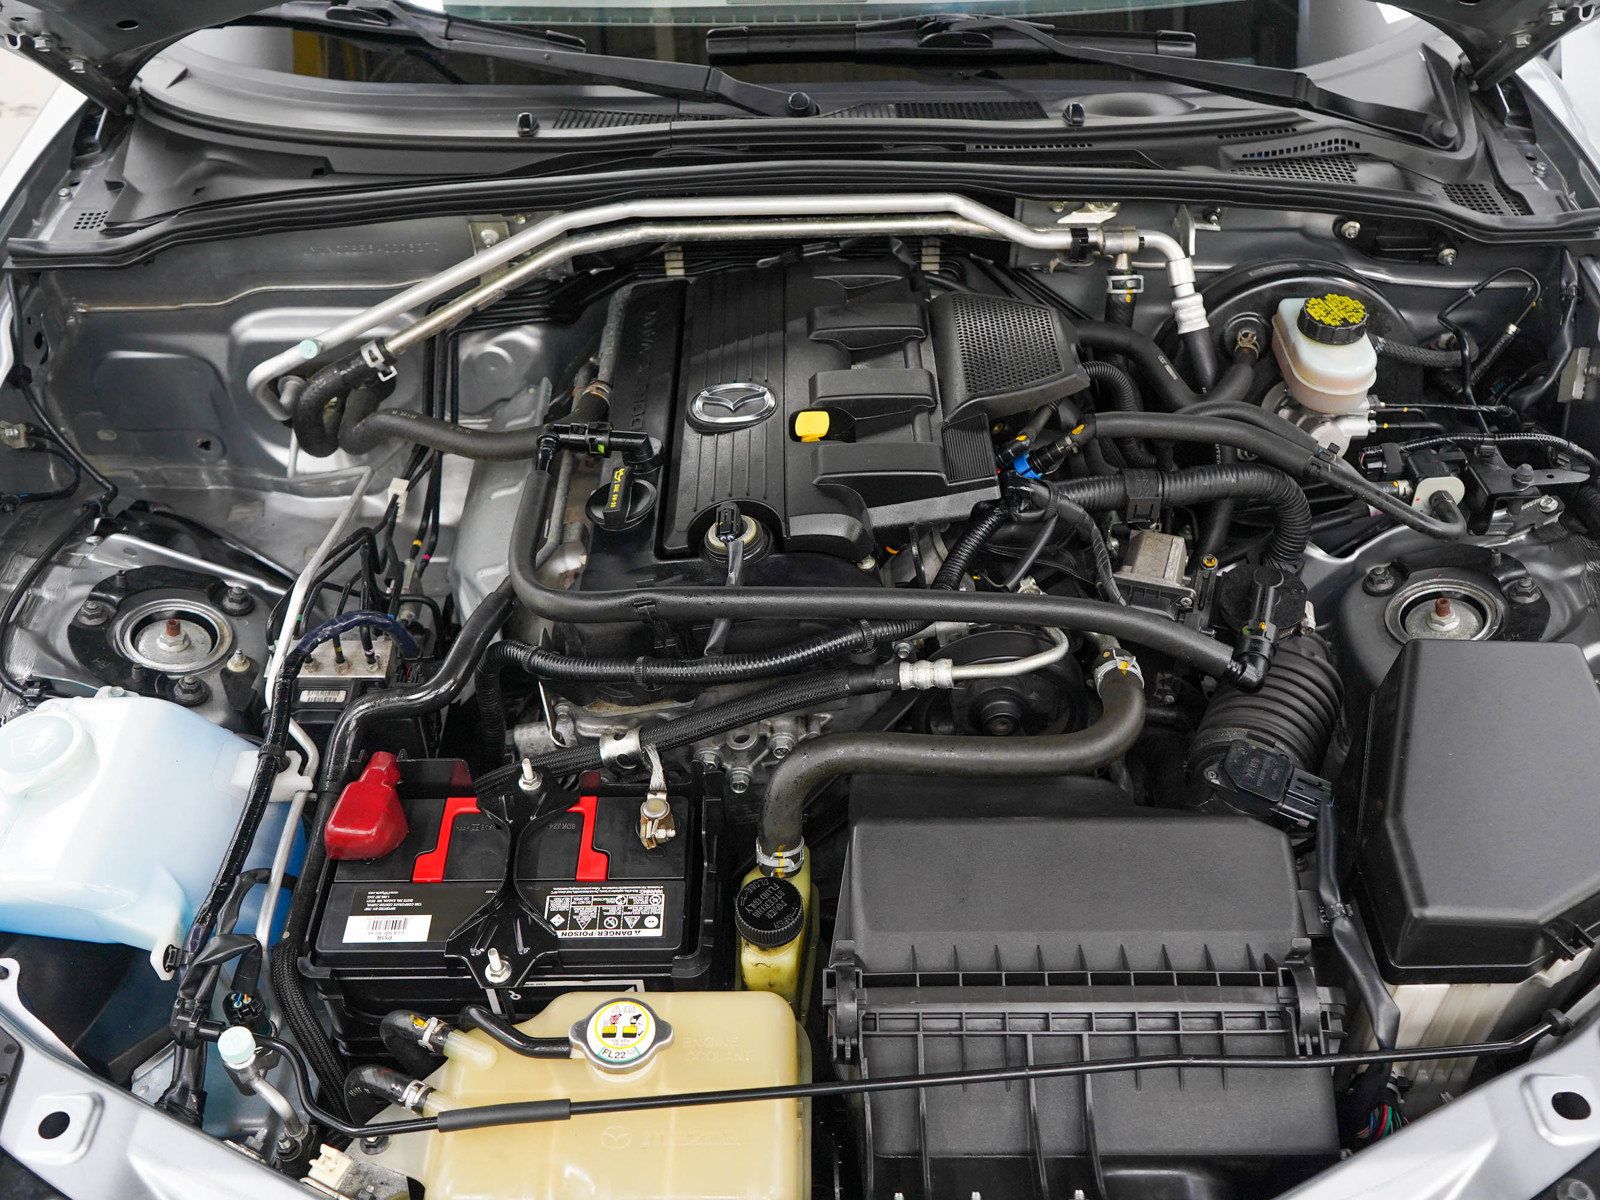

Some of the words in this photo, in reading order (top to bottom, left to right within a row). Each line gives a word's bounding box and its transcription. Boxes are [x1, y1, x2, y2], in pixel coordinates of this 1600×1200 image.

[760, 882, 780, 900] FLUID
[745, 898, 762, 914] ONLY
[752, 889, 785, 918] STEERING
[765, 900, 787, 919] POWER
[601, 1048, 626, 1059] FL22
